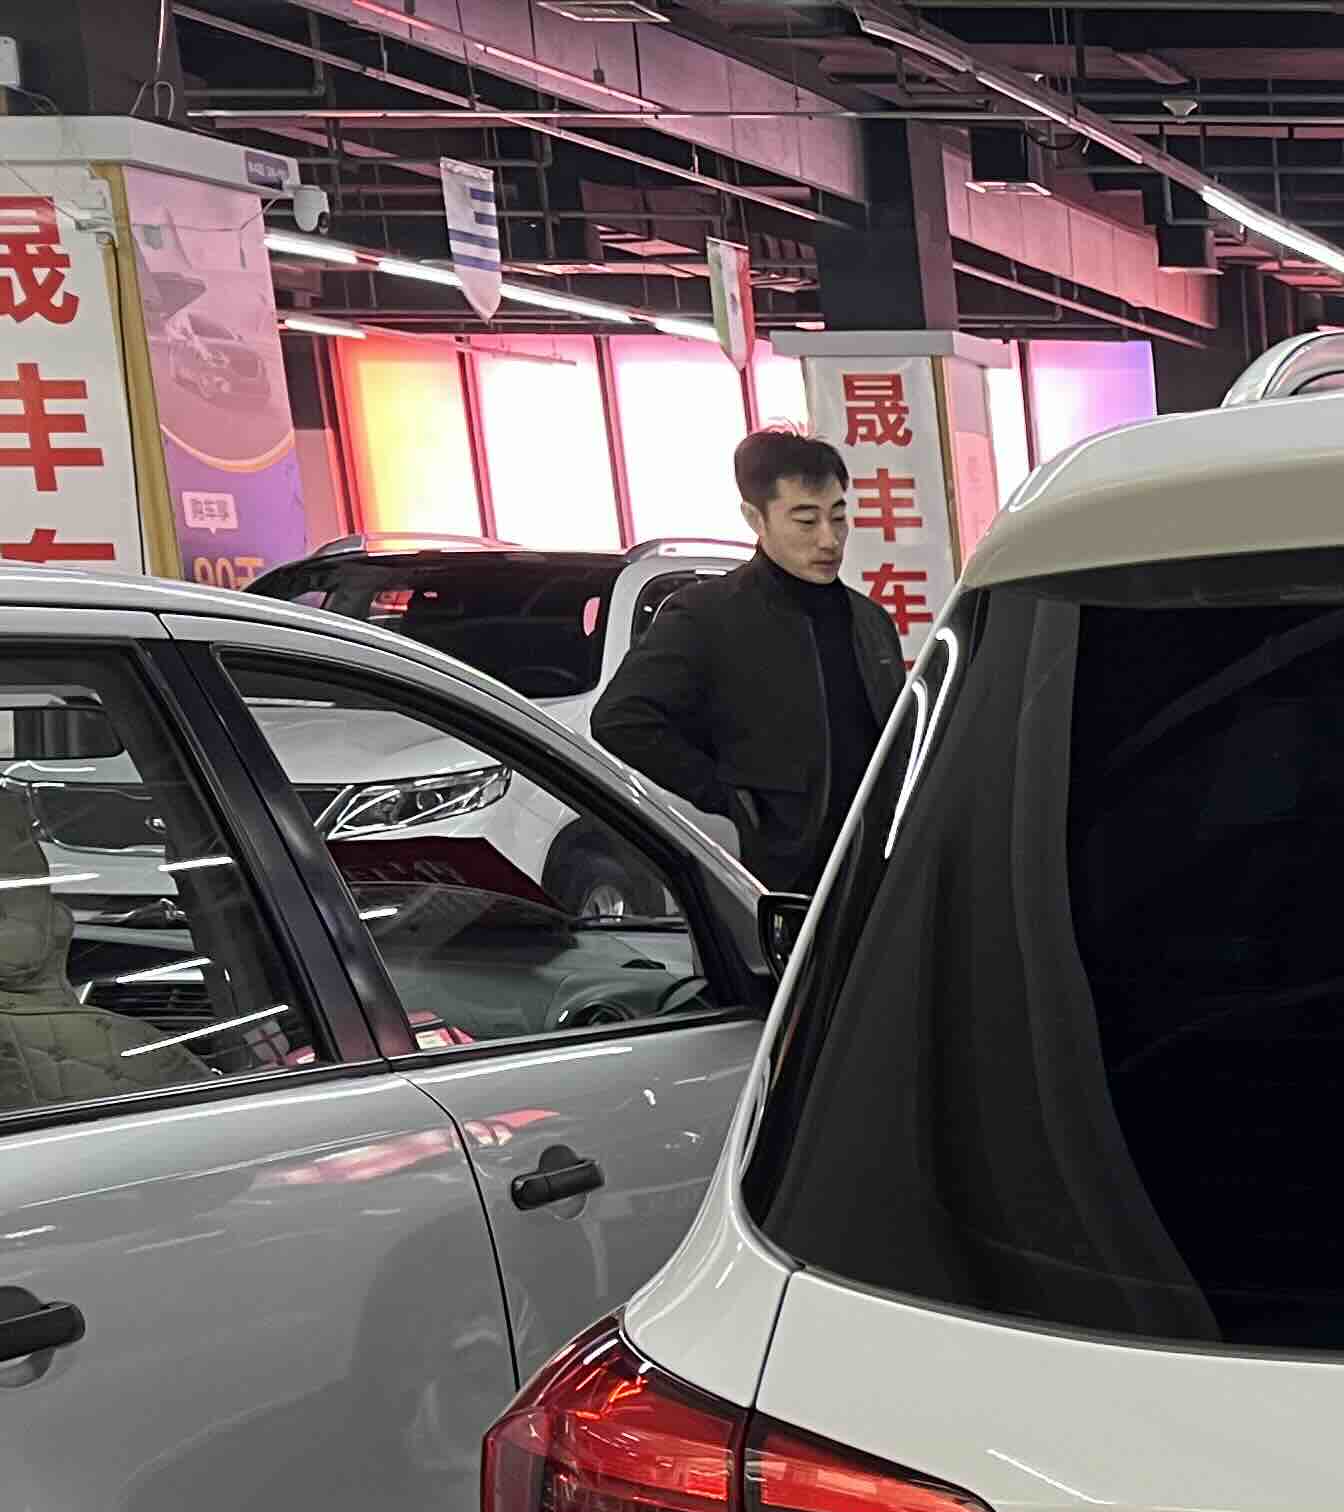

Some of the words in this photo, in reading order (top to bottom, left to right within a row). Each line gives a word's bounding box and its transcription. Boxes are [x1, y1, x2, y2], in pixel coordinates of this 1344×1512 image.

[0, 196, 116, 563] 晟丰
[842, 374, 934, 672] 晟丰车
